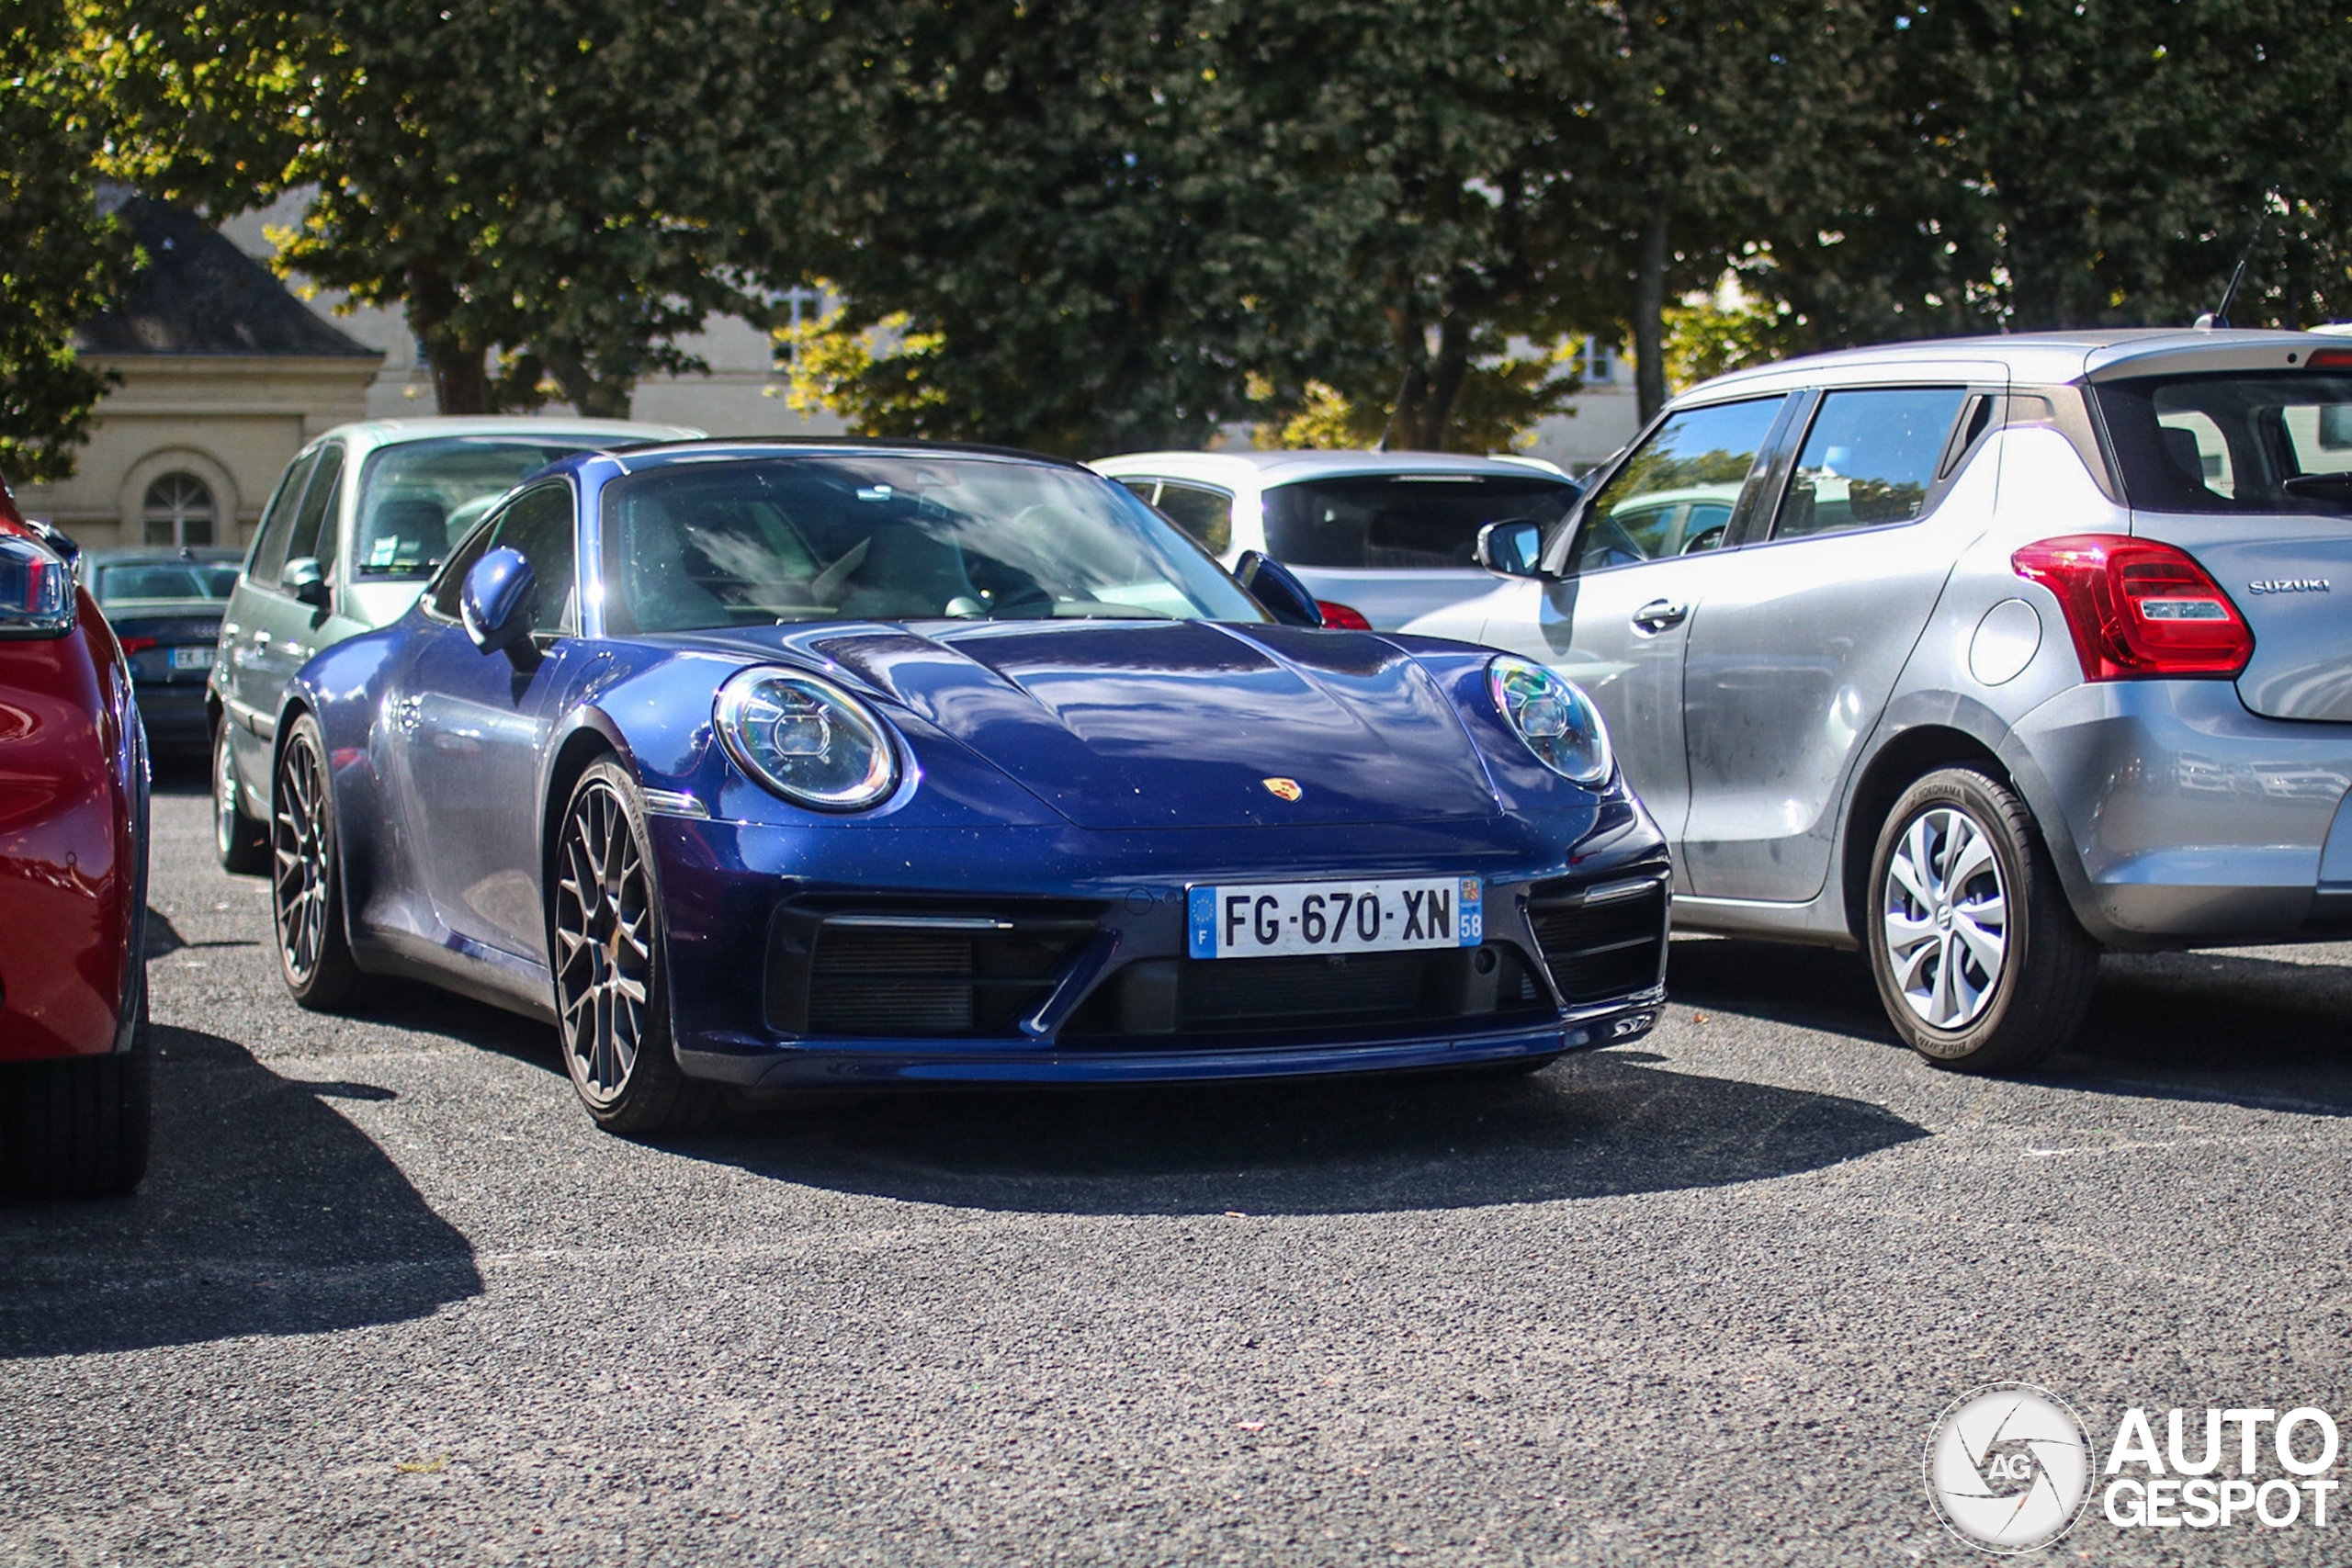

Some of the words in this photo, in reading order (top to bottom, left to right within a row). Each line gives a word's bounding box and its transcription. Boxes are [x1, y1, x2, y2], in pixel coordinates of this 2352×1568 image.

[2248, 578, 2331, 595] SUZUKI
[1225, 888, 1451, 947] FG-670-XN
[1460, 914, 1482, 938] 58
[1198, 930, 1207, 945] F
